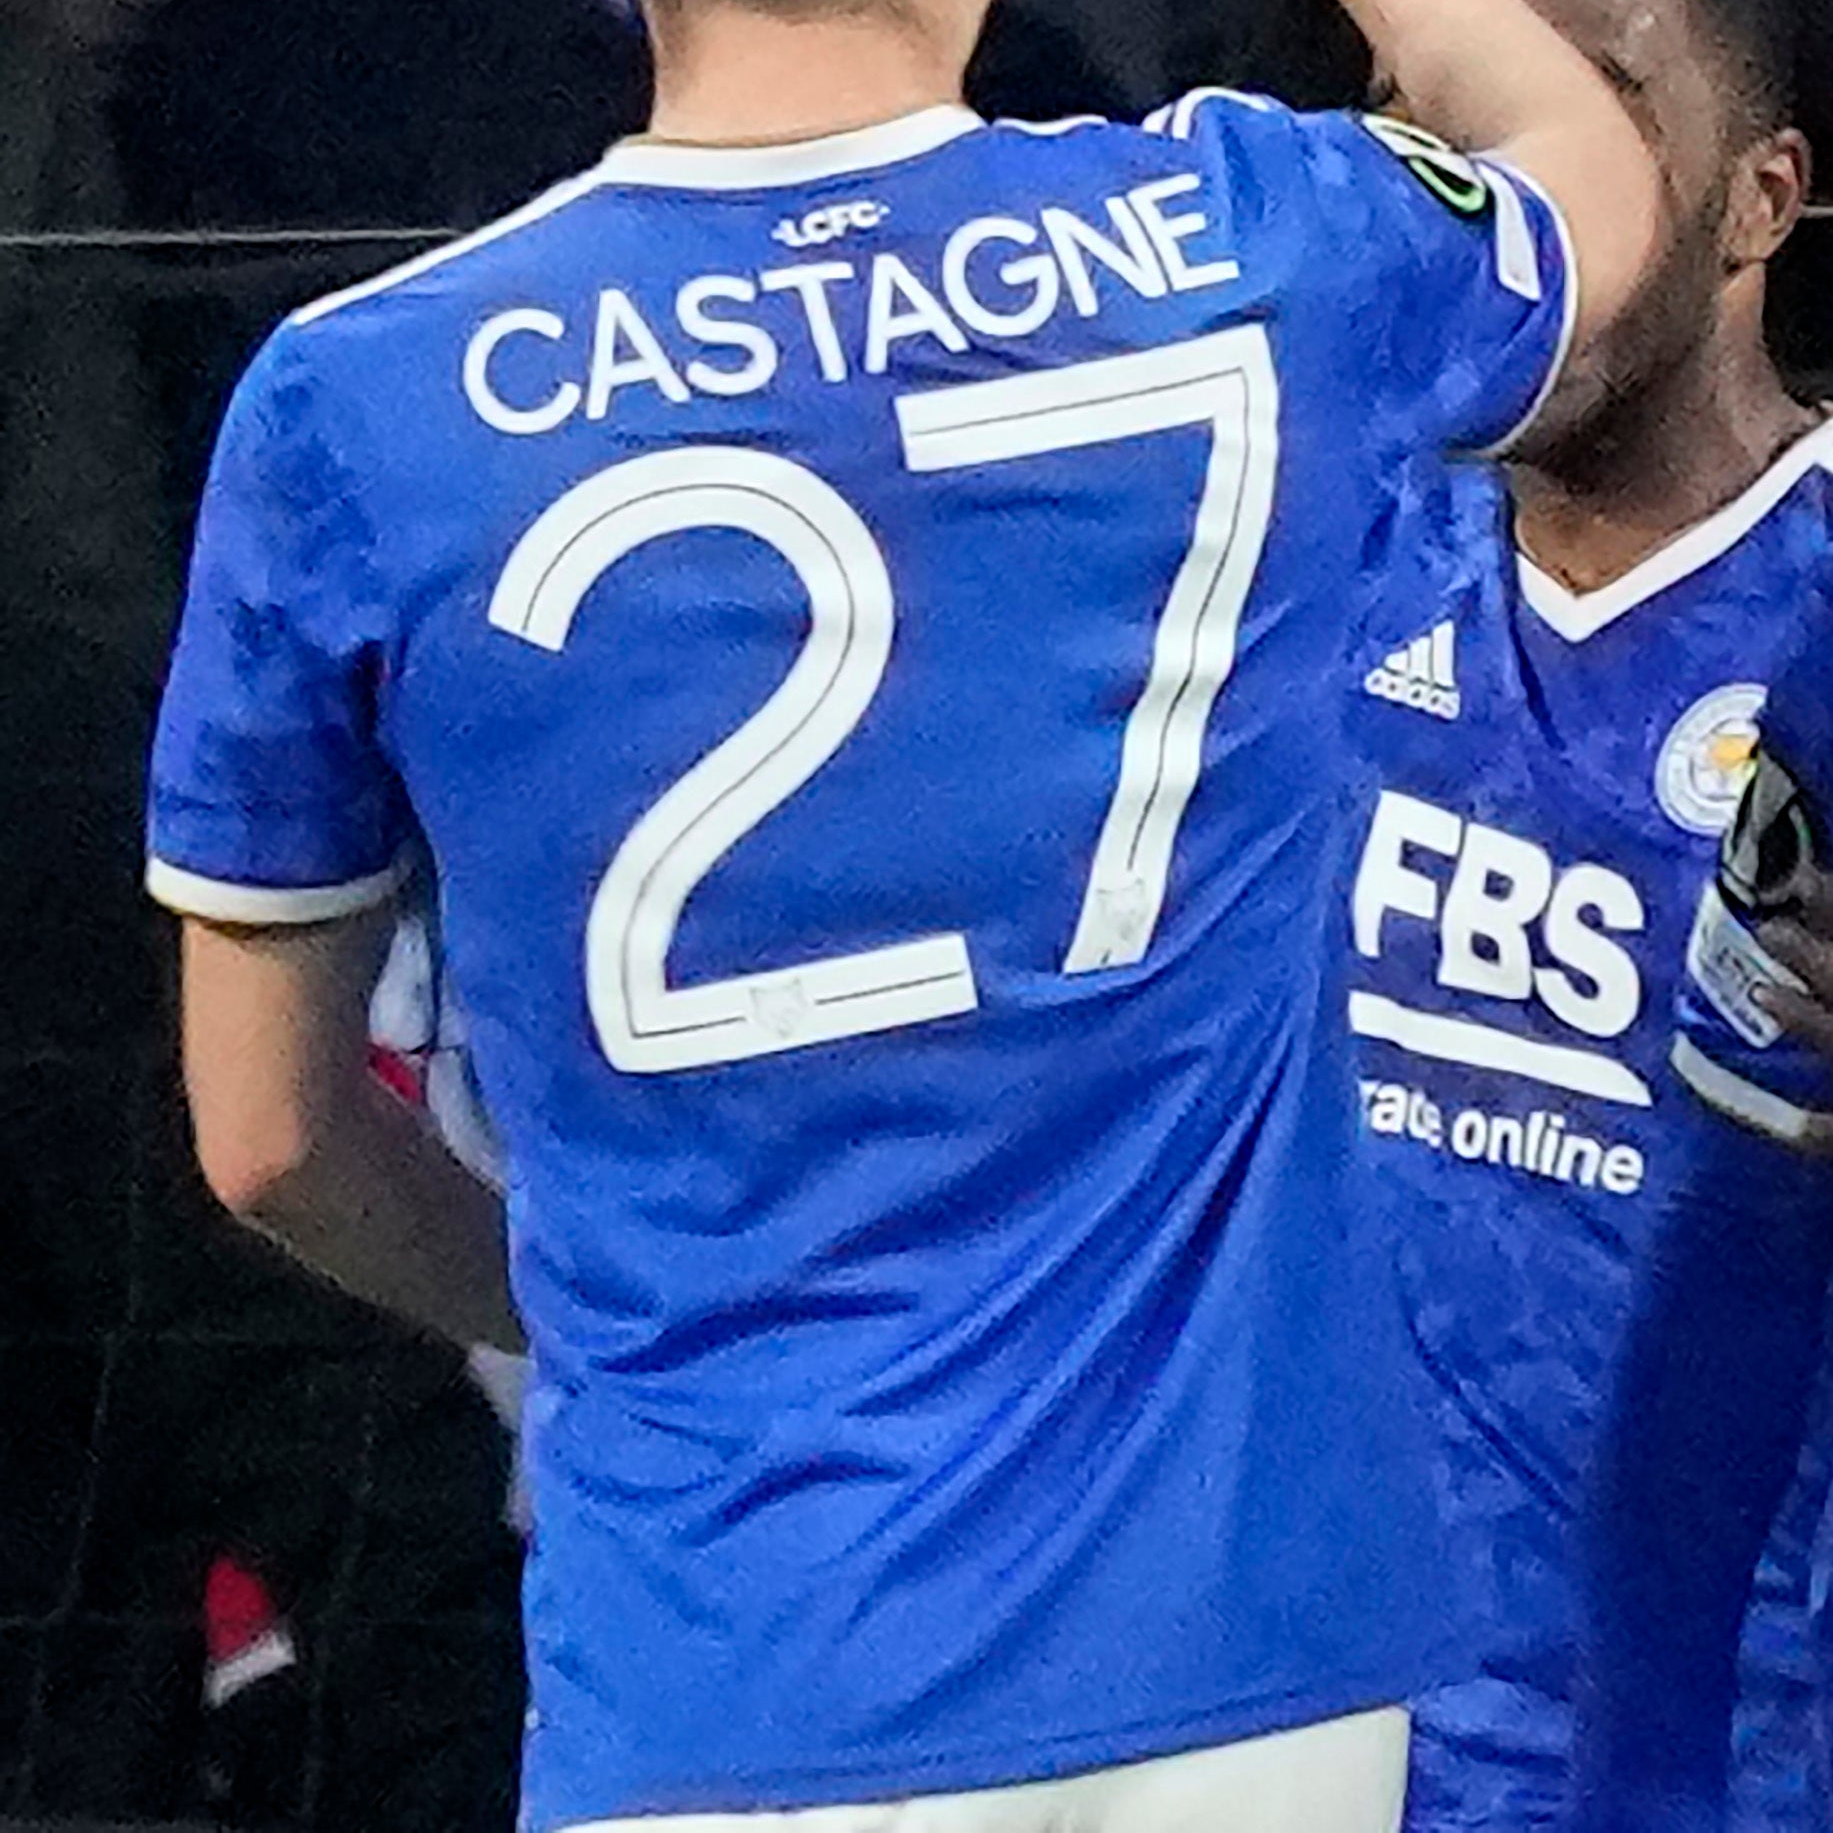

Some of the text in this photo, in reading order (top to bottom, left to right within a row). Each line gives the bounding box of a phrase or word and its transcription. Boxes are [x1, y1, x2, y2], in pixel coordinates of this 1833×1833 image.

[462, 171, 1240, 435] CASTAGNE
[487, 322, 1279, 1074] 27
[1353, 789, 1645, 1040] FBS
[1451, 1109, 1645, 1196] online
